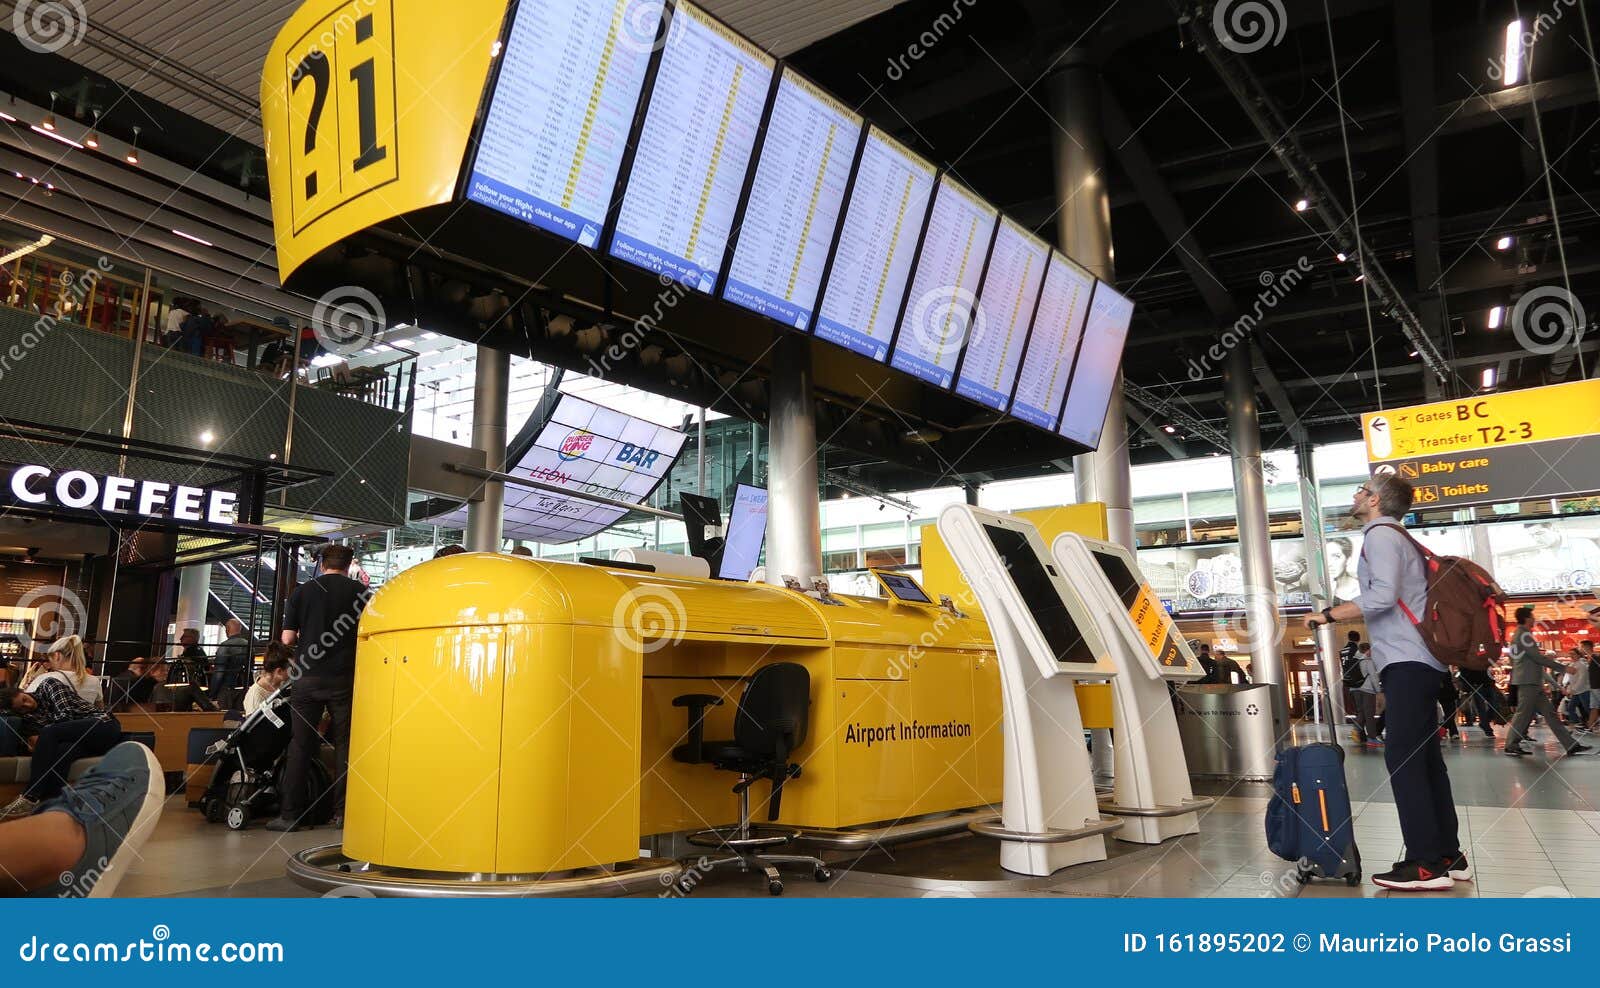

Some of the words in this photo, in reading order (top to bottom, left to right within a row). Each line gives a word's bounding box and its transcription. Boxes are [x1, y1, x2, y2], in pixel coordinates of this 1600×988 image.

[474, 182, 499, 197] Follow
[498, 193, 515, 204] your
[534, 207, 553, 220] check
[564, 220, 577, 230] app
[1415, 409, 1452, 424] Gates
[561, 441, 593, 452] KING
[565, 434, 595, 444] BURGER
[1418, 432, 1473, 448] Transfer
[615, 442, 660, 469] BAR
[1421, 459, 1456, 474] Baby
[1459, 456, 1489, 470] care
[529, 466, 572, 484] LEON
[11, 464, 237, 525] COFFEE
[1441, 482, 1489, 497] Toilets
[845, 722, 897, 747] Airport
[899, 720, 971, 741] Information
